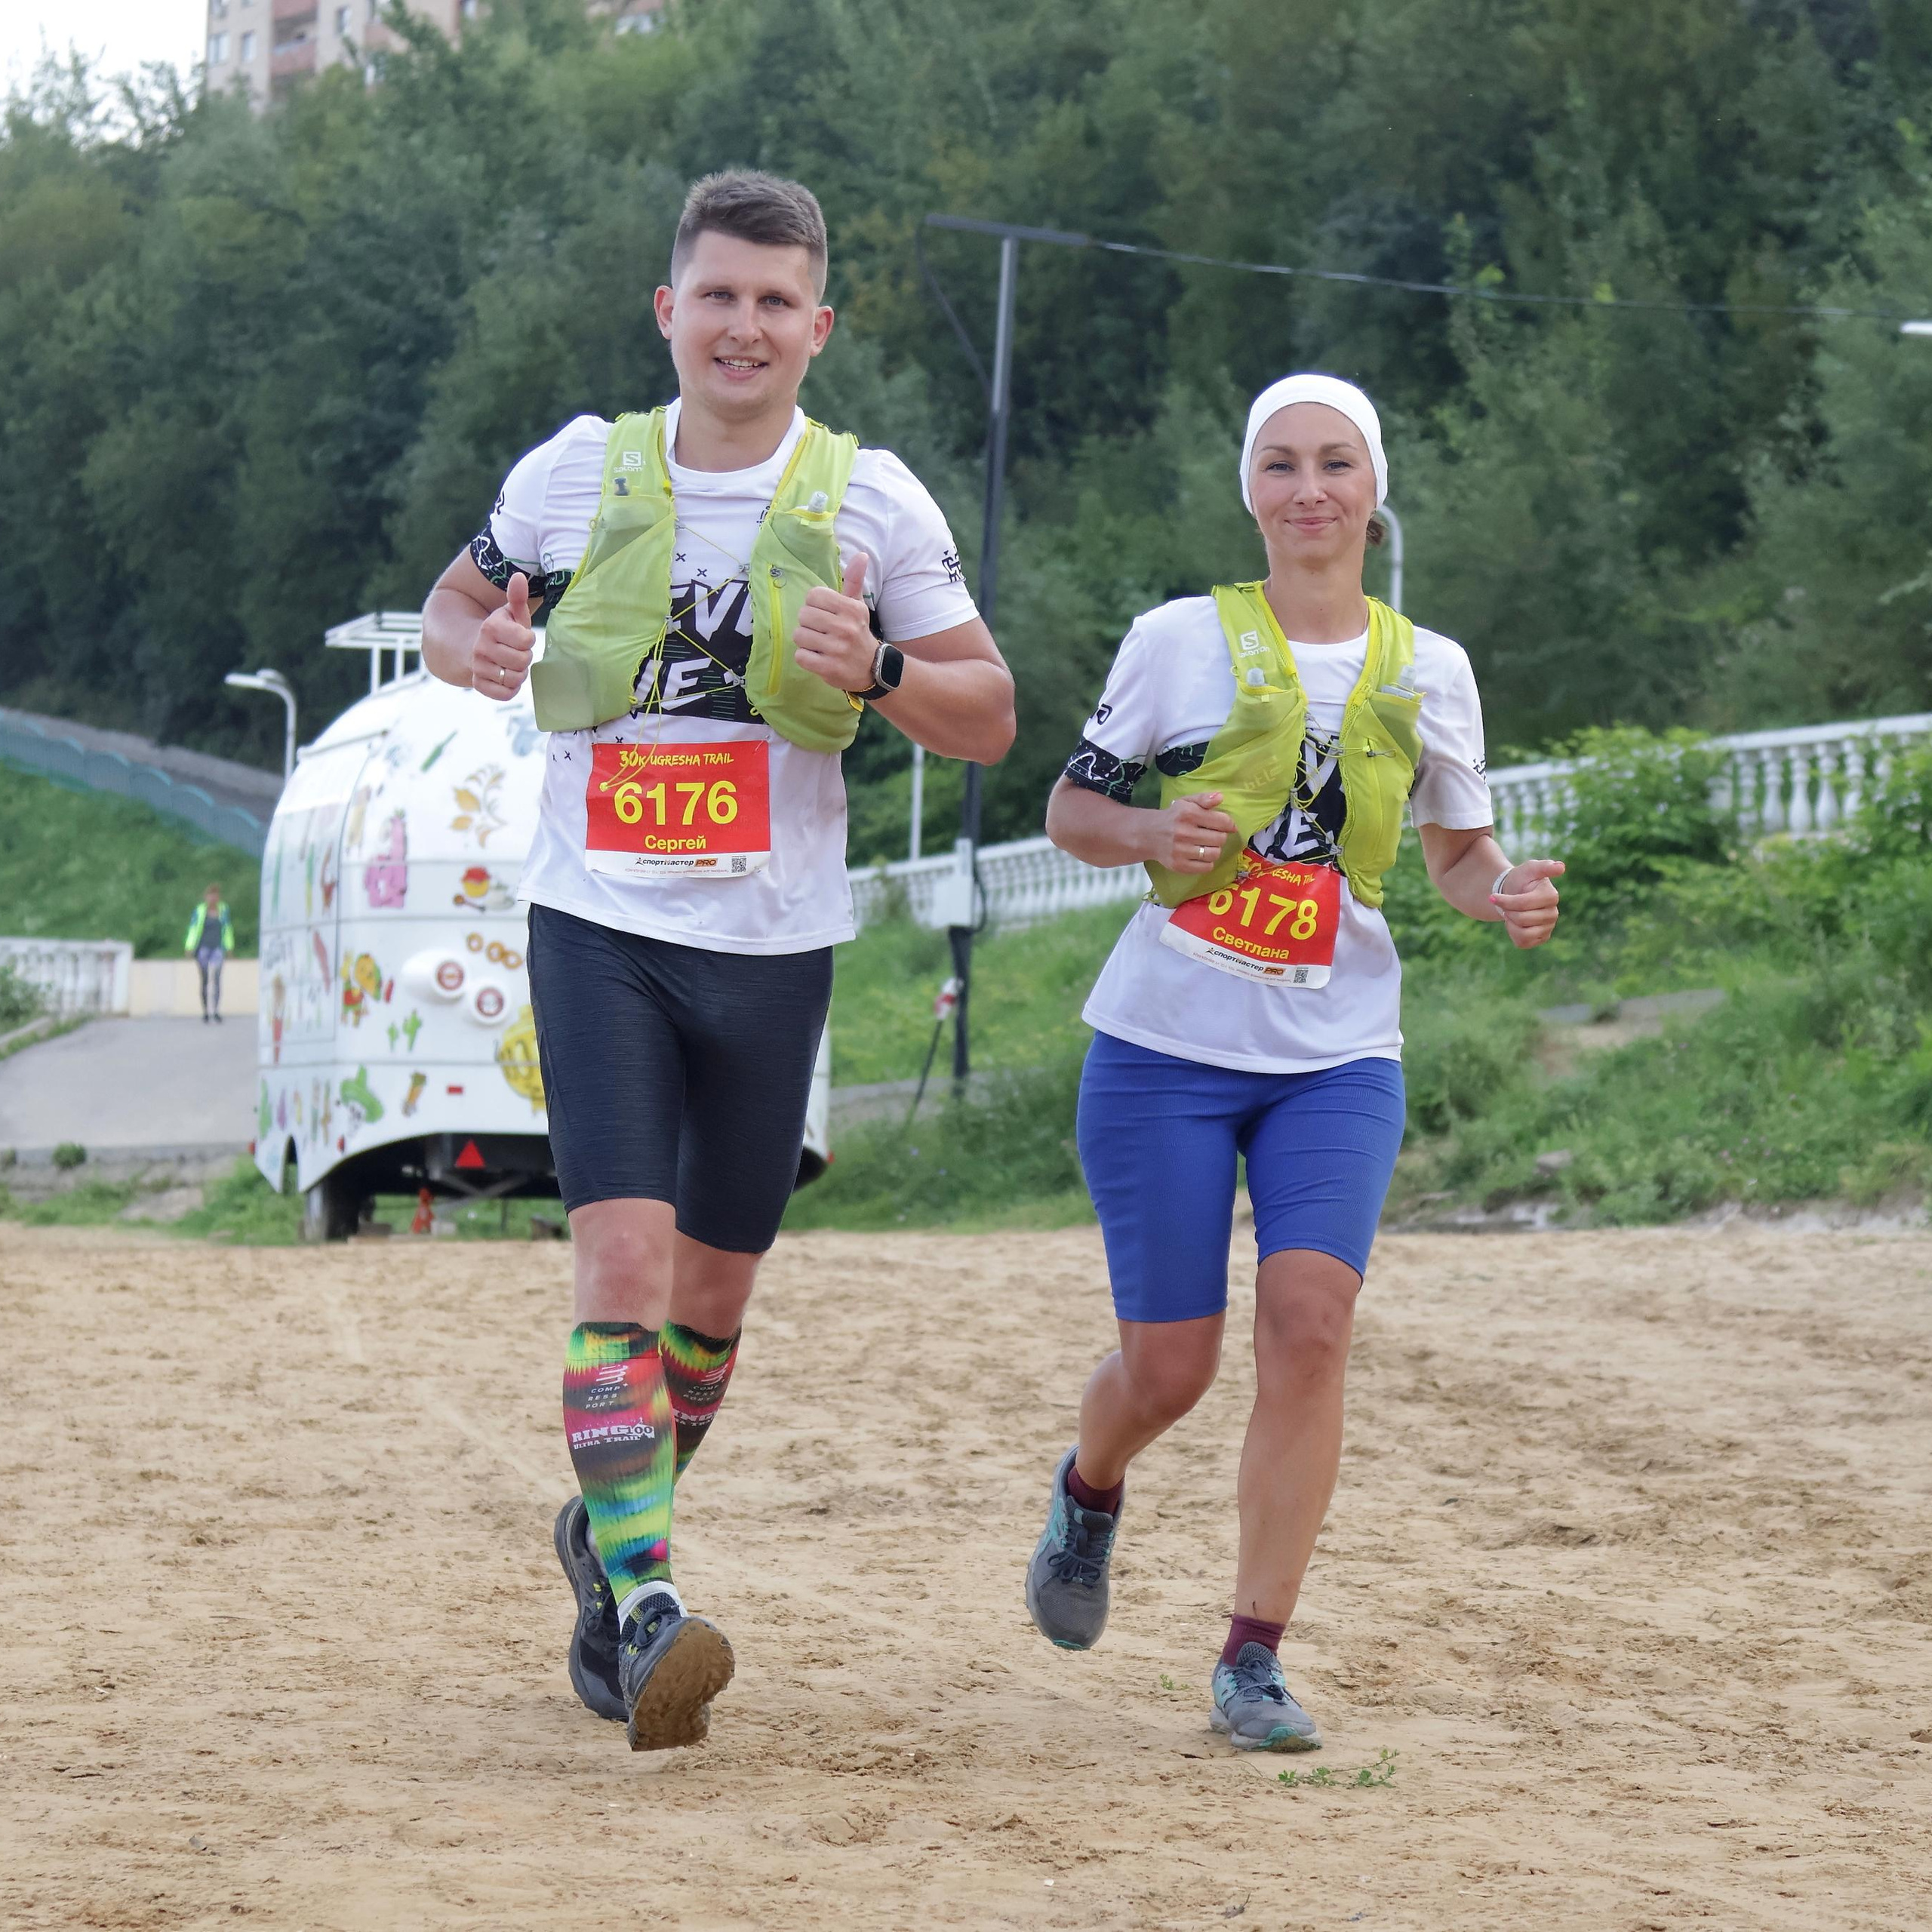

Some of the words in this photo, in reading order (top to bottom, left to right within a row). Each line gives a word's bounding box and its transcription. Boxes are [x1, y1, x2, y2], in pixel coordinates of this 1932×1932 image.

[650, 755, 700, 767] UGRESHA
[703, 752, 734, 765] TRAIL
[614, 780, 738, 826] 6176
[645, 835, 706, 853] Сергей
[1208, 884, 1318, 940] 6178
[1212, 927, 1290, 960] Светлана
[587, 1393, 618, 1401] RESS
[591, 1386, 620, 1394] COMP
[585, 1401, 614, 1410] PORT
[574, 1439, 601, 1450] ULTRA
